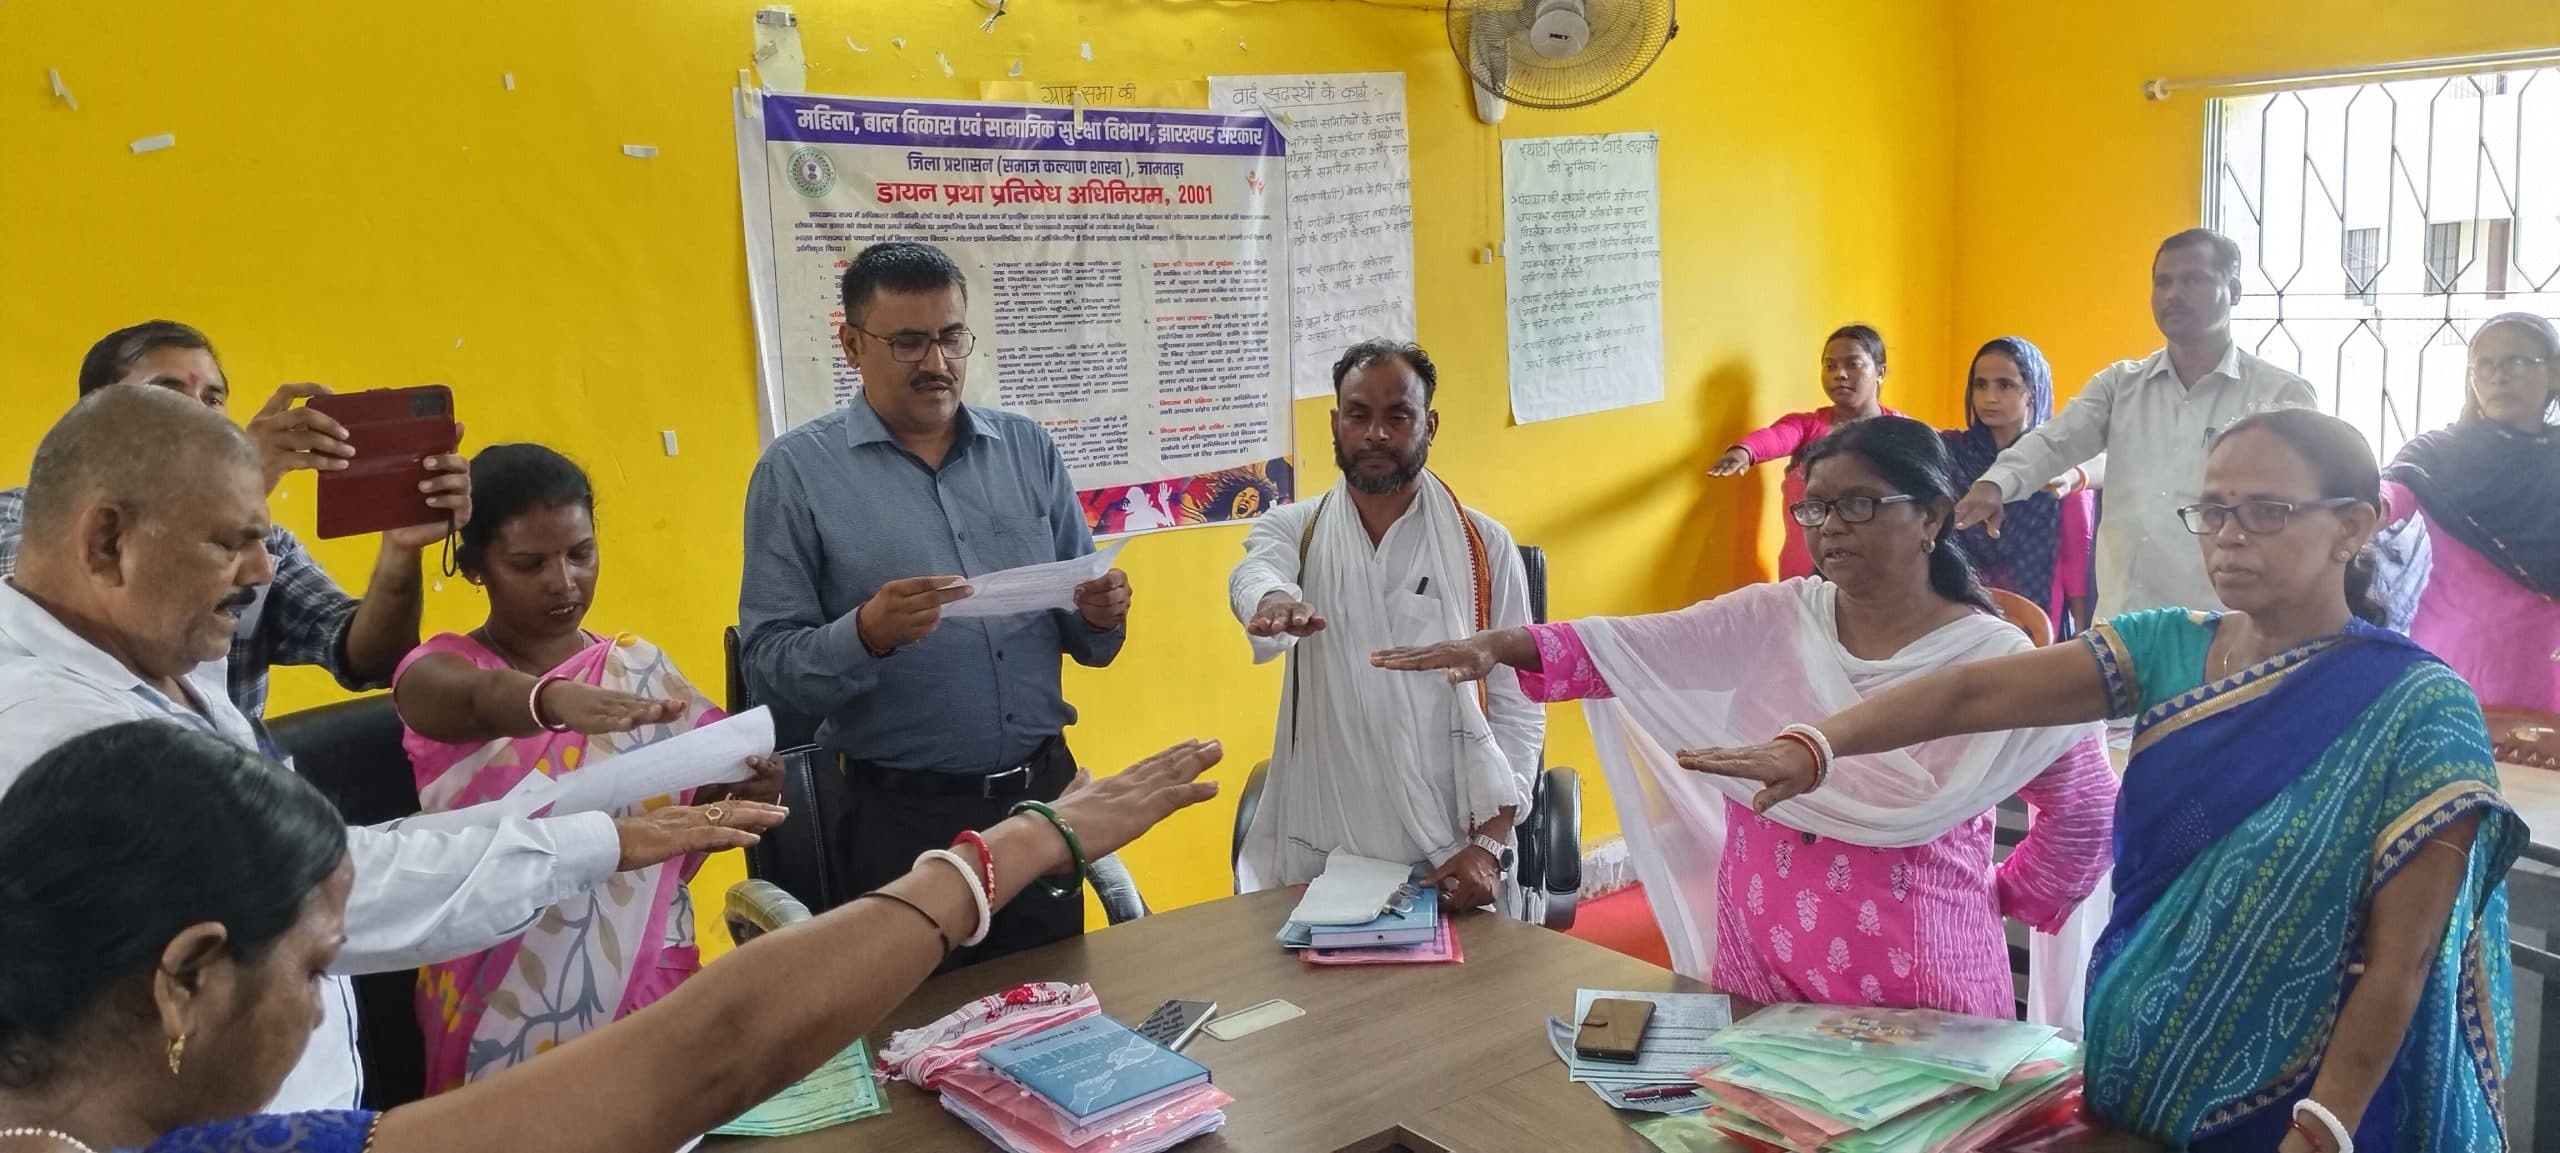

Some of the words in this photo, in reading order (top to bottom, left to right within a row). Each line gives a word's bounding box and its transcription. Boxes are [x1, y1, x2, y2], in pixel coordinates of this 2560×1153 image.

[1081, 85, 1113, 105] सभा
[1118, 83, 1136, 103] की
[795, 104, 860, 135] महिला,
[862, 112, 899, 134] बाल
[901, 109, 956, 136] विकास
[959, 112, 984, 137] एवं
[985, 114, 1057, 139] सामाजिक
[1104, 116, 1155, 145] विभाग,
[1156, 123, 1216, 144] झारखण्ड
[1217, 126, 1263, 145] सरकार
[907, 152, 941, 172] जिला
[943, 156, 993, 173] प्रशासन
[997, 155, 1040, 177] (समाज
[1042, 160, 1087, 175] कल्याण
[1090, 160, 1122, 176] शाखा
[1137, 161, 1184, 179] जामताड़ा
[876, 182, 938, 204] डायन
[943, 182, 984, 206] प्रथा
[990, 177, 1063, 207] प्रतिषेध
[1066, 178, 1171, 206] अधिनियम,
[1178, 184, 1213, 204] 2001
